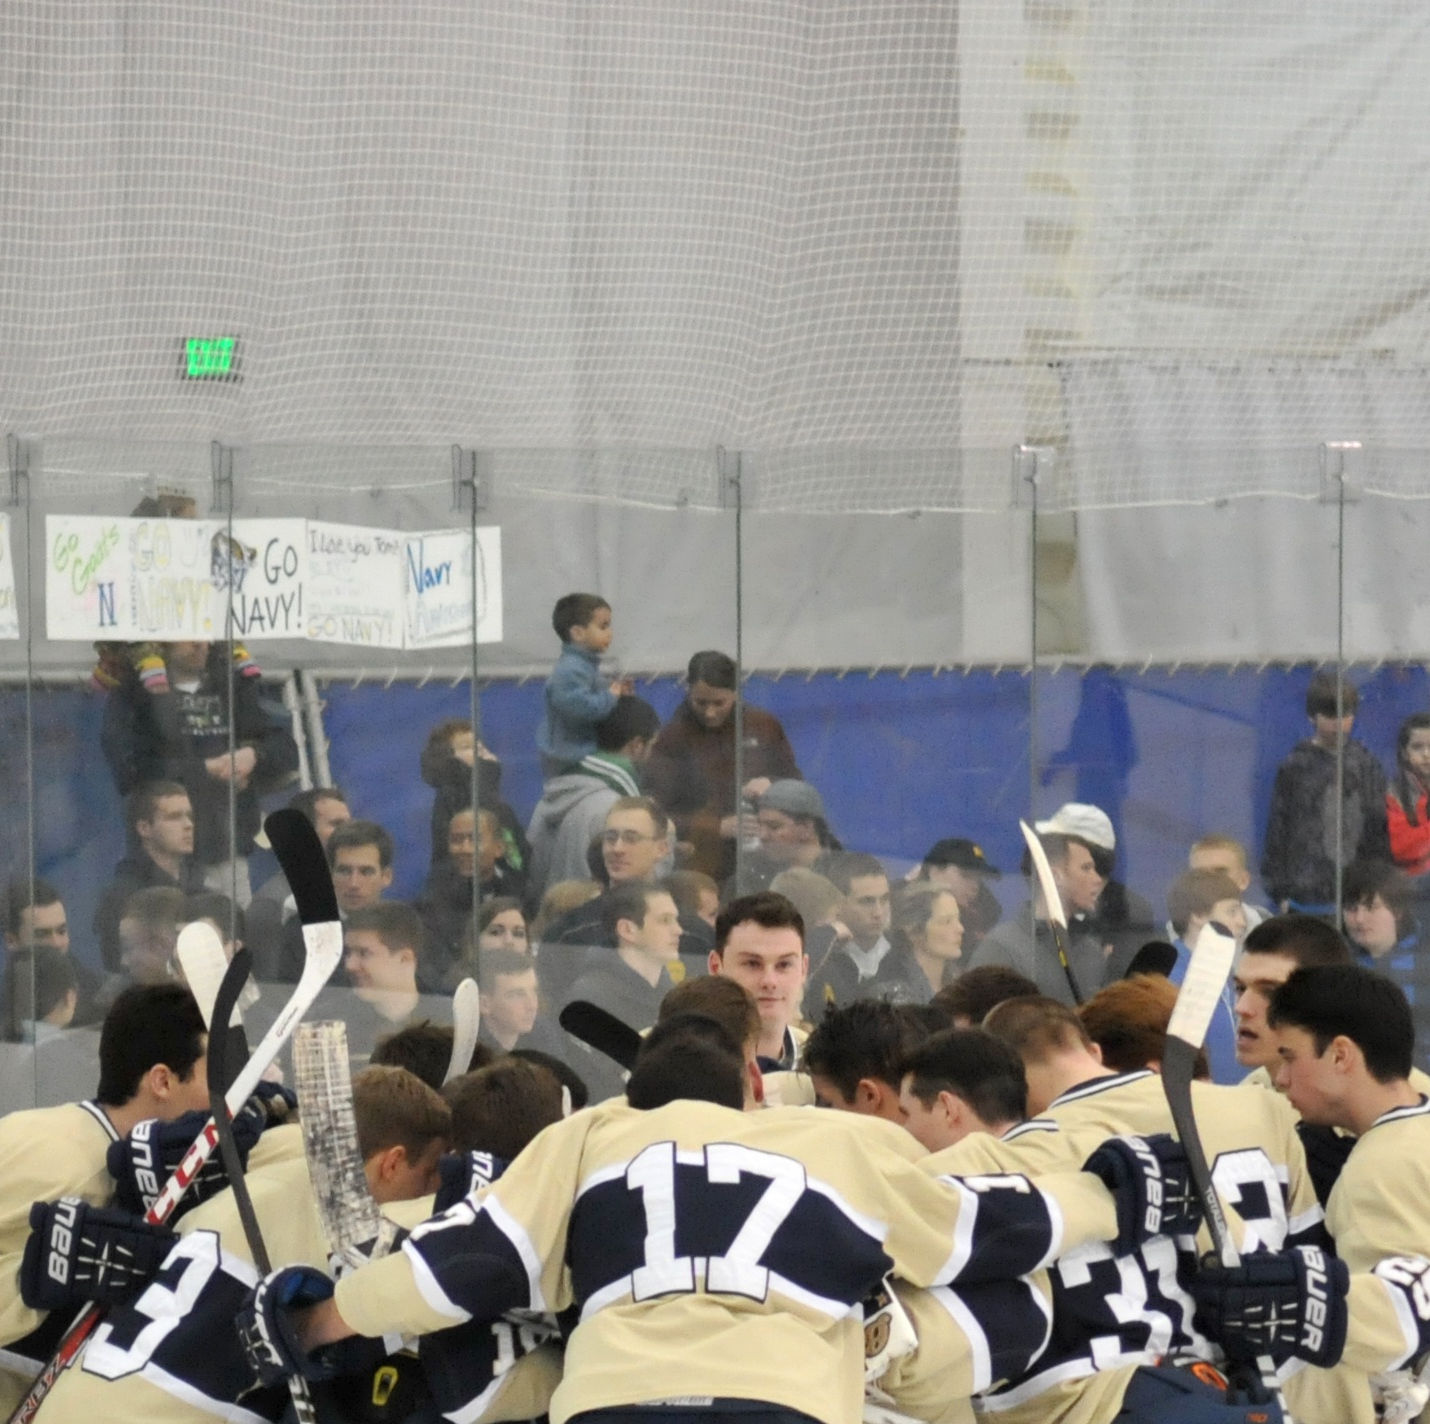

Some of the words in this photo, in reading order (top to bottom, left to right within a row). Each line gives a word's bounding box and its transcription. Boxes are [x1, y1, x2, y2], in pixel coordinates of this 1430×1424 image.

[264, 537, 298, 584] GO
[97, 581, 118, 627] N
[225, 581, 303, 637] NAVY!
[625, 1141, 808, 1304] 17
[54, 1228, 223, 1382] 3
[1295, 1244, 1328, 1353] AUER
